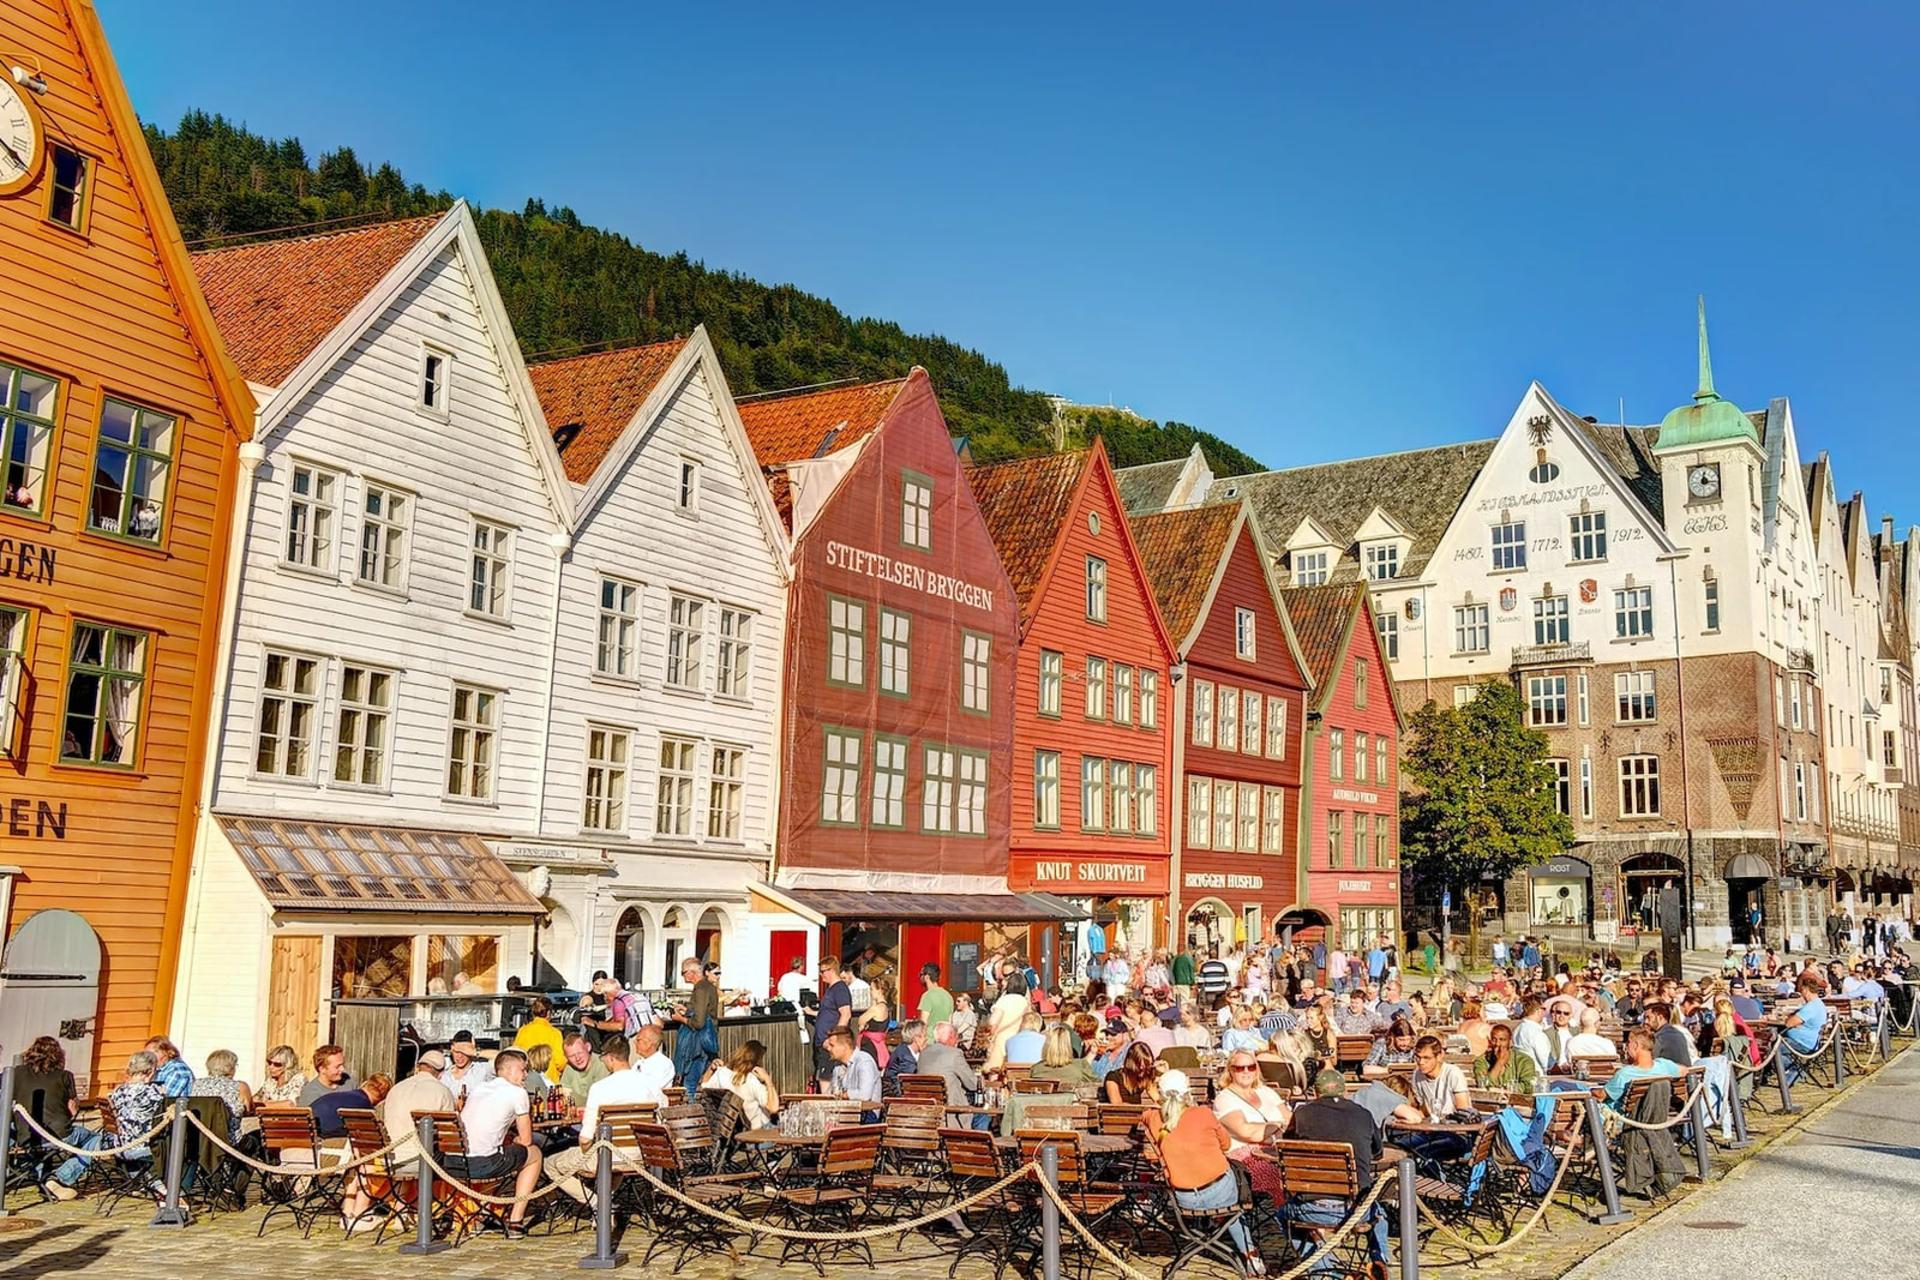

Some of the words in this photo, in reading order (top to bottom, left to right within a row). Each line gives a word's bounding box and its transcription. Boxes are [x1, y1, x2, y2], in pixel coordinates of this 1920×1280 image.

[1531, 536, 1563, 553] 1712.
[1612, 527, 1644, 543] 1912.
[826, 540, 925, 592] STIFTELSEN
[926, 571, 993, 611] BRYGGEN
[0, 798, 67, 839] EN
[1036, 861, 1073, 880] KNUT
[1078, 862, 1147, 883] SKURTVEIT
